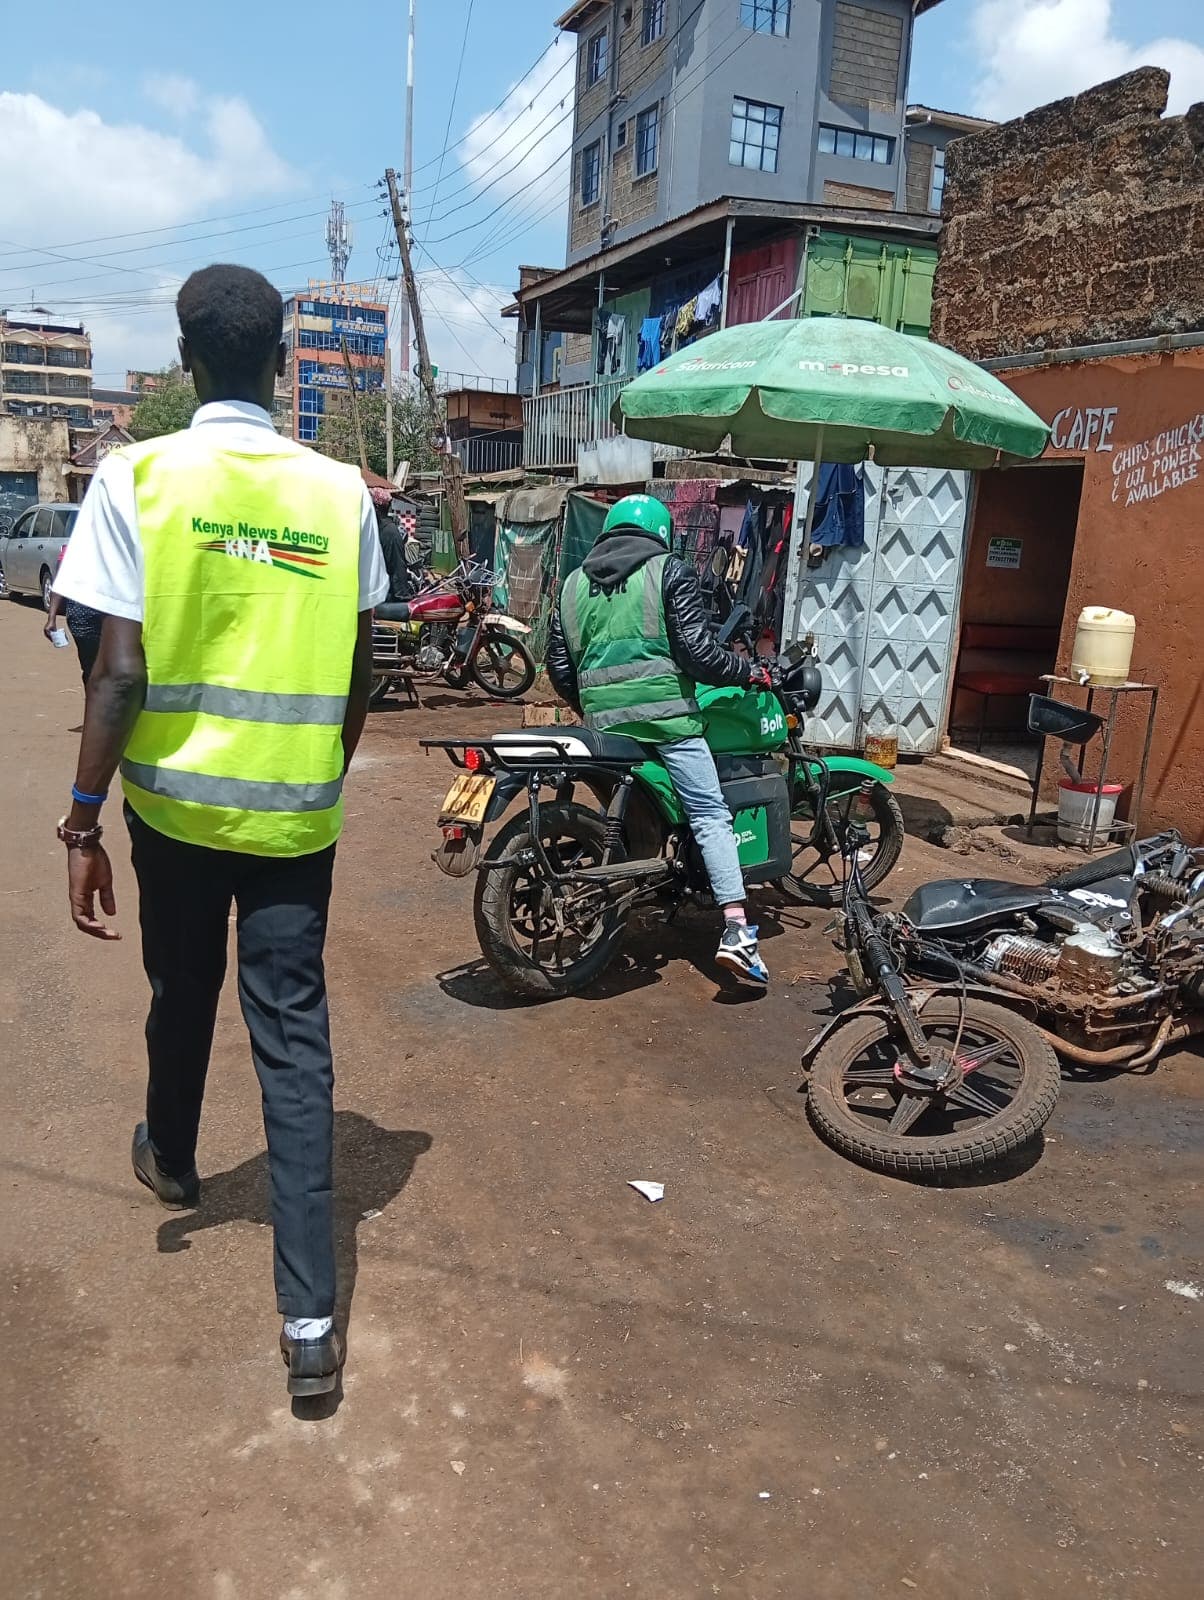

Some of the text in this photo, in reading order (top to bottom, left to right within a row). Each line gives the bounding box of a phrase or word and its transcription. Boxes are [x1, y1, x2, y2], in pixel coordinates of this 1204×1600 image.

[1050, 406, 1118, 453] CAFE
[1125, 466, 1146, 489] UJI
[1152, 443, 1202, 478] POWER
[1125, 463, 1199, 508] AVAILABLE
[192, 517, 329, 550] Kenya News Agency
[225, 540, 274, 566] KNA
[760, 713, 783, 737] Bolt
